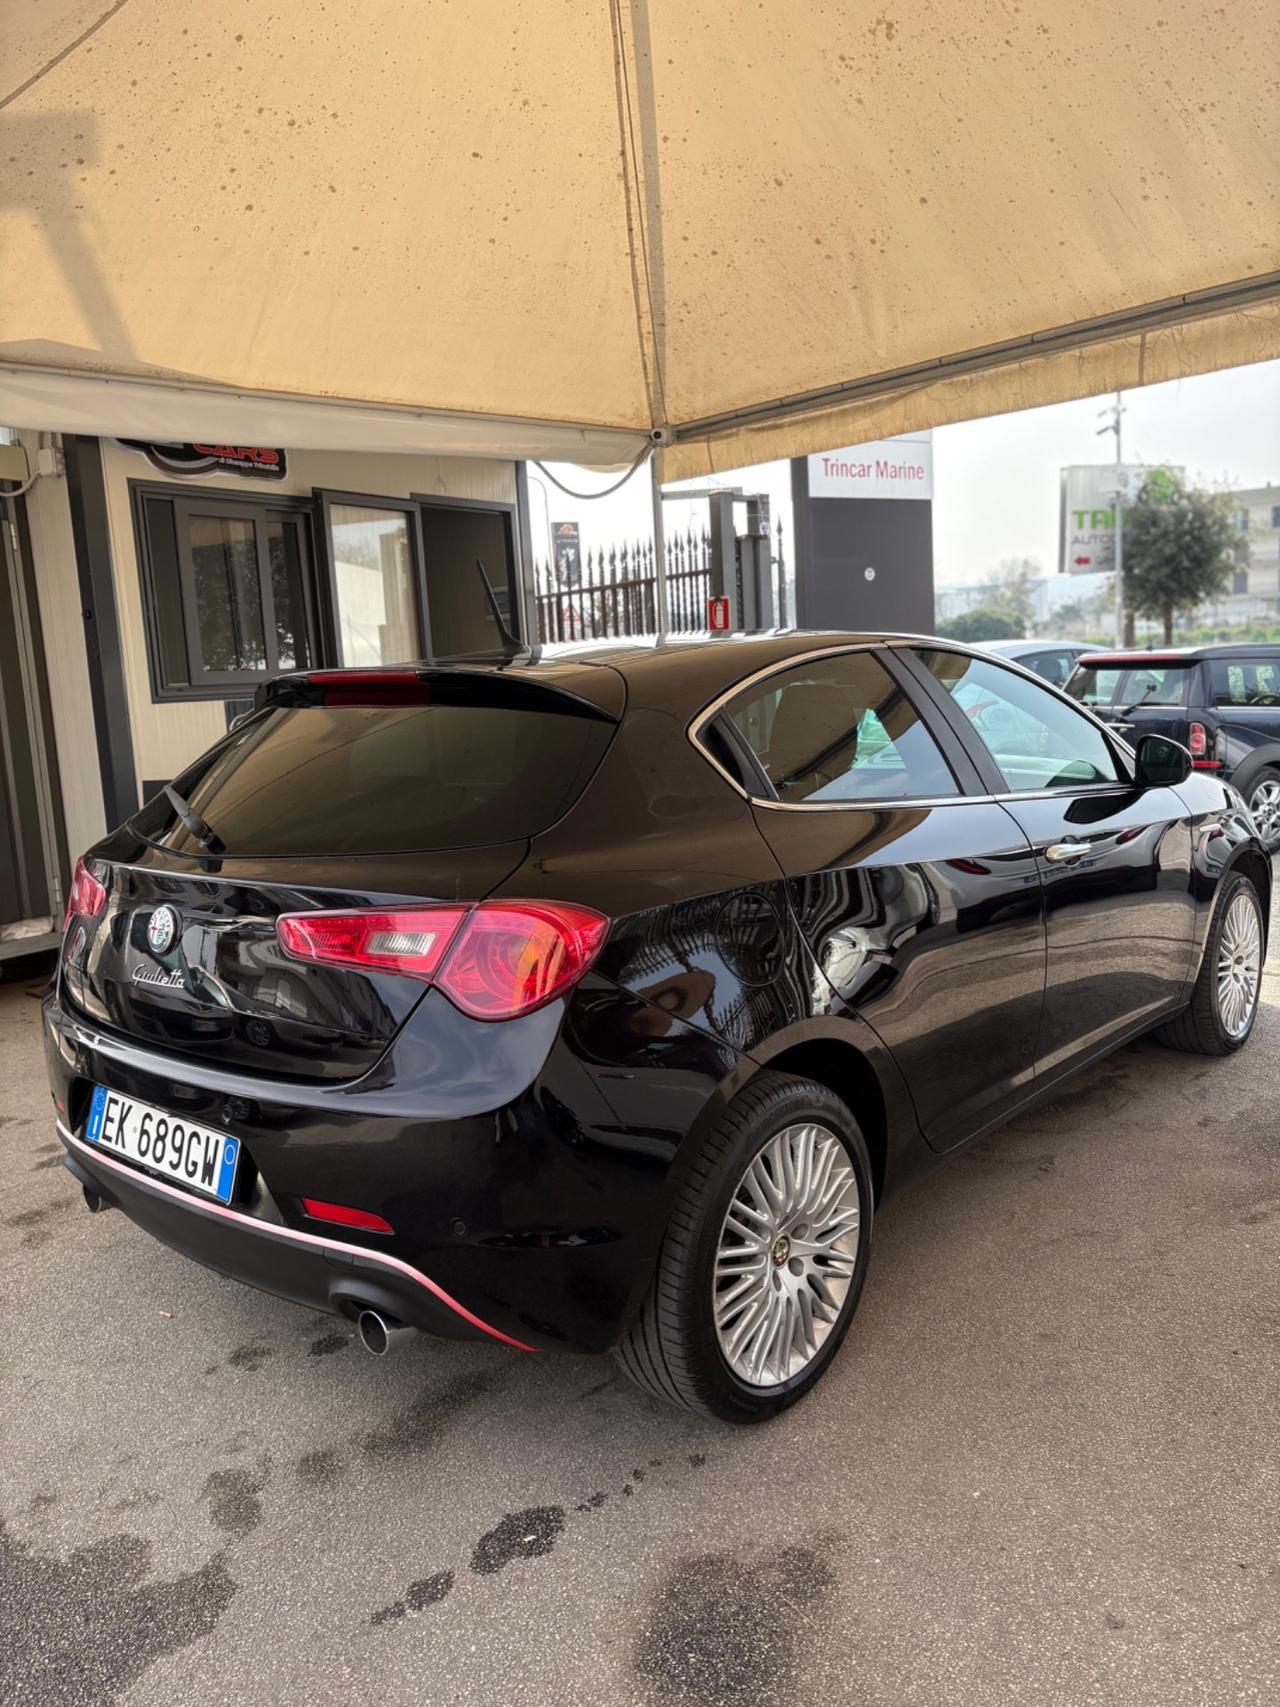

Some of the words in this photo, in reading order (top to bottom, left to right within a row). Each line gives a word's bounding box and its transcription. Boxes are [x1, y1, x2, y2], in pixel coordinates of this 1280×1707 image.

[192, 443, 279, 464] CARS
[822, 458, 872, 478] Trincar
[876, 460, 925, 480] Marine
[132, 963, 186, 989] Giulietta
[101, 1096, 133, 1149] EK
[137, 1112, 220, 1187] 689GW
